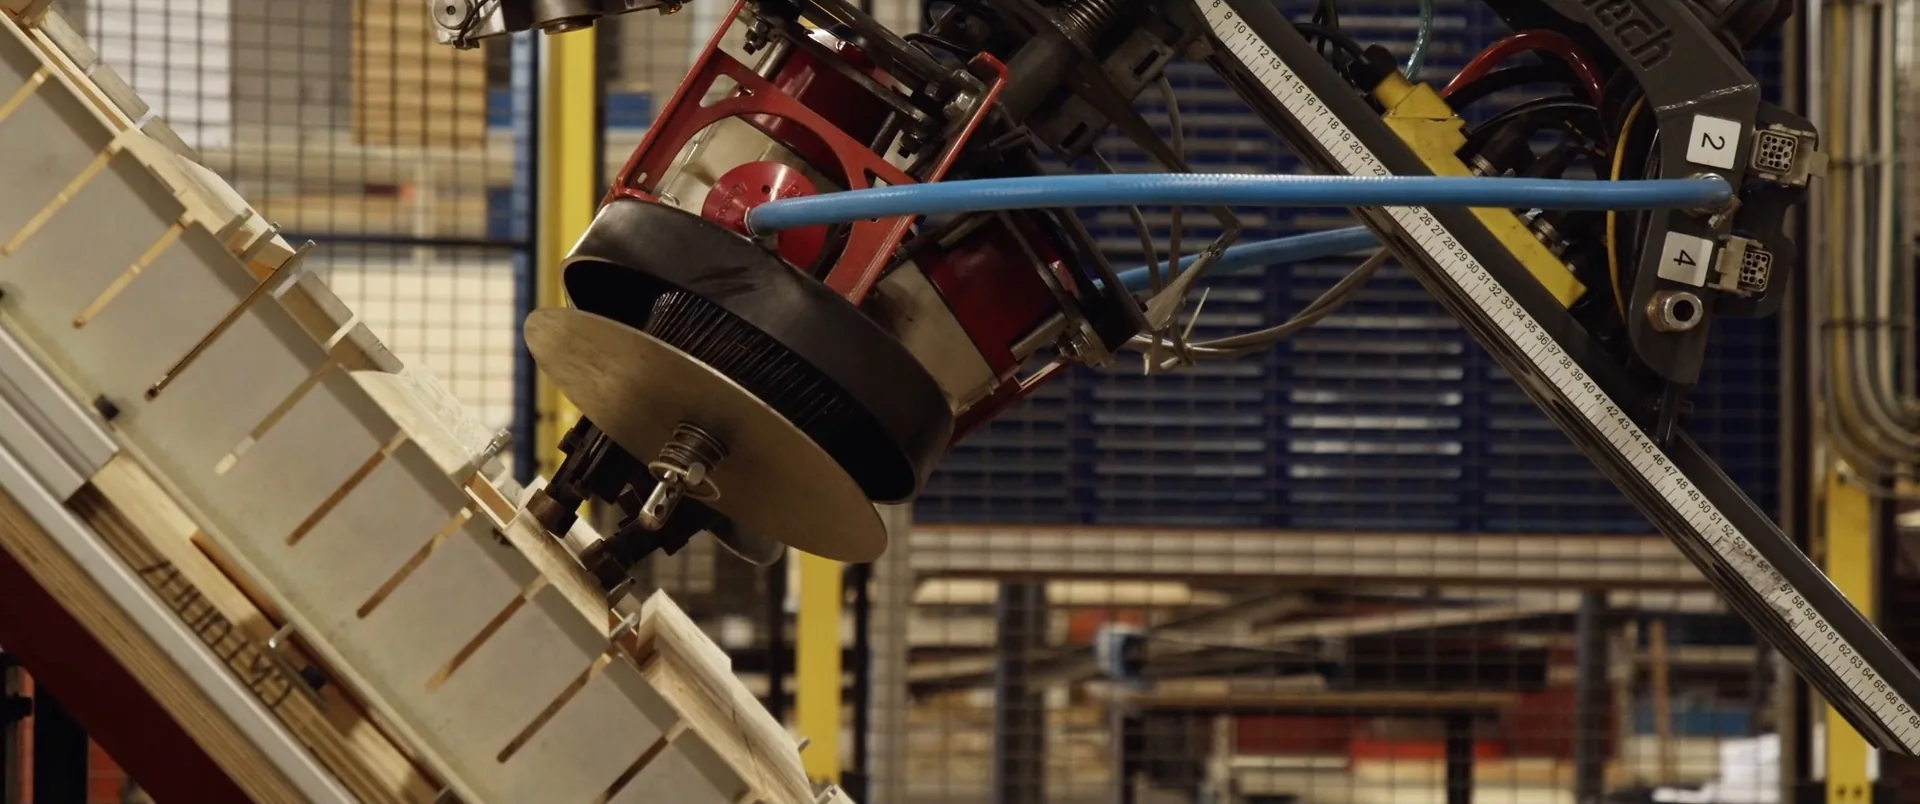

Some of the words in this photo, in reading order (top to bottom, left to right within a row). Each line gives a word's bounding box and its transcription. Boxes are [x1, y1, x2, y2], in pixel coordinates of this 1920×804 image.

[1212, 0, 1221, 8] 8
[1224, 11, 1233, 20] 9
[1234, 21, 1246, 34] 10
[1246, 33, 1258, 45] 11
[1257, 45, 1270, 58] 12
[1269, 57, 1282, 70] 13
[1280, 69, 1293, 82] 14
[1292, 81, 1305, 94] 15
[1304, 93, 1316, 106] 16
[1316, 105, 1329, 116] 17
[1327, 117, 1339, 130] 18
[1339, 129, 1351, 142] 19
[1349, 141, 1363, 154] 20
[1361, 153, 1374, 166] 21
[1372, 165, 1387, 177] 22
[1701, 132, 1725, 150] 2
[1673, 250, 1696, 266] 4
[1419, 213, 1433, 226] 26
[1430, 224, 1445, 236] 27
[1442, 236, 1456, 250] 28
[1454, 248, 1468, 262] 29
[1466, 260, 1479, 274] 30
[1477, 272, 1491, 285] 31
[1488, 283, 1502, 297] 32
[1501, 296, 1514, 309] 33
[1512, 308, 1526, 321] 34
[1524, 320, 1538, 333] 35
[1536, 332, 1549, 345] 36
[1547, 344, 1561, 356] 37
[1559, 356, 1572, 370] 38
[1570, 368, 1584, 381] 39
[1583, 381, 1596, 394] 40
[1594, 392, 1607, 405] 41
[1606, 404, 1619, 418] 42
[1617, 416, 1630, 430] 43
[1629, 428, 1642, 442] 44
[1641, 441, 1654, 454] 45
[1652, 453, 1666, 466] 46
[1664, 464, 1678, 476] 47
[1676, 477, 1688, 490] 48
[1687, 488, 1700, 501] 49
[1698, 500, 1711, 513] 50
[1709, 512, 1722, 525] 51
[1721, 524, 1735, 538] 52
[1780, 583, 1794, 595] 57
[1791, 595, 1805, 609] 58
[1803, 607, 1817, 621] 59
[1815, 619, 1828, 633] 60
[1826, 631, 1839, 644] 61
[1838, 643, 1852, 657] 62
[1850, 655, 1863, 669] 63
[1861, 667, 1875, 681] 64
[1873, 679, 1887, 693] 65
[1885, 691, 1899, 705] 66
[1897, 703, 1911, 715] 67
[1909, 715, 1920, 729] 68
